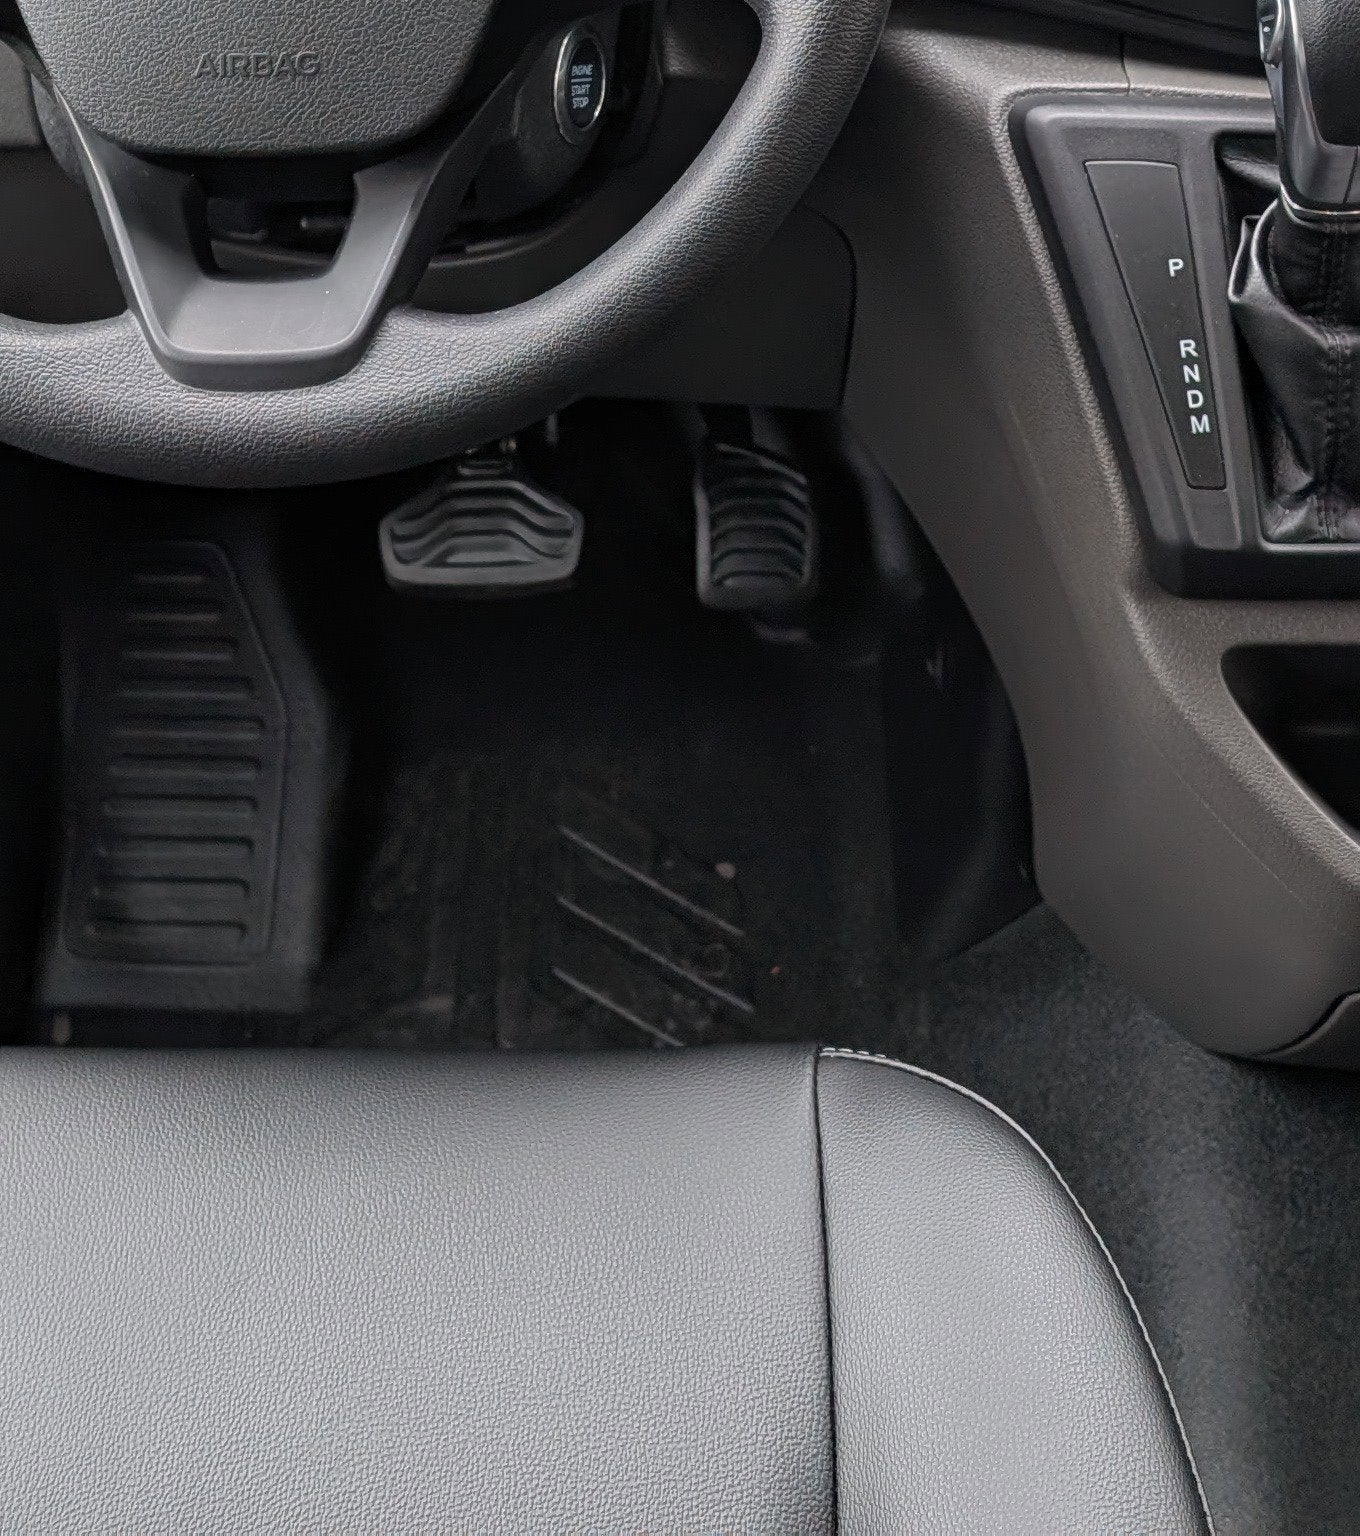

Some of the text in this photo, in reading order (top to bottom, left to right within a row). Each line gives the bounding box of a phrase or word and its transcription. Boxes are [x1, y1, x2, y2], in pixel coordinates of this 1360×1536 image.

[192, 50, 321, 79] AIRBAG
[1168, 258, 1184, 277] P
[1179, 339, 1199, 359] R
[1182, 363, 1201, 383] N
[1186, 389, 1204, 409] D
[1190, 414, 1211, 435] M
